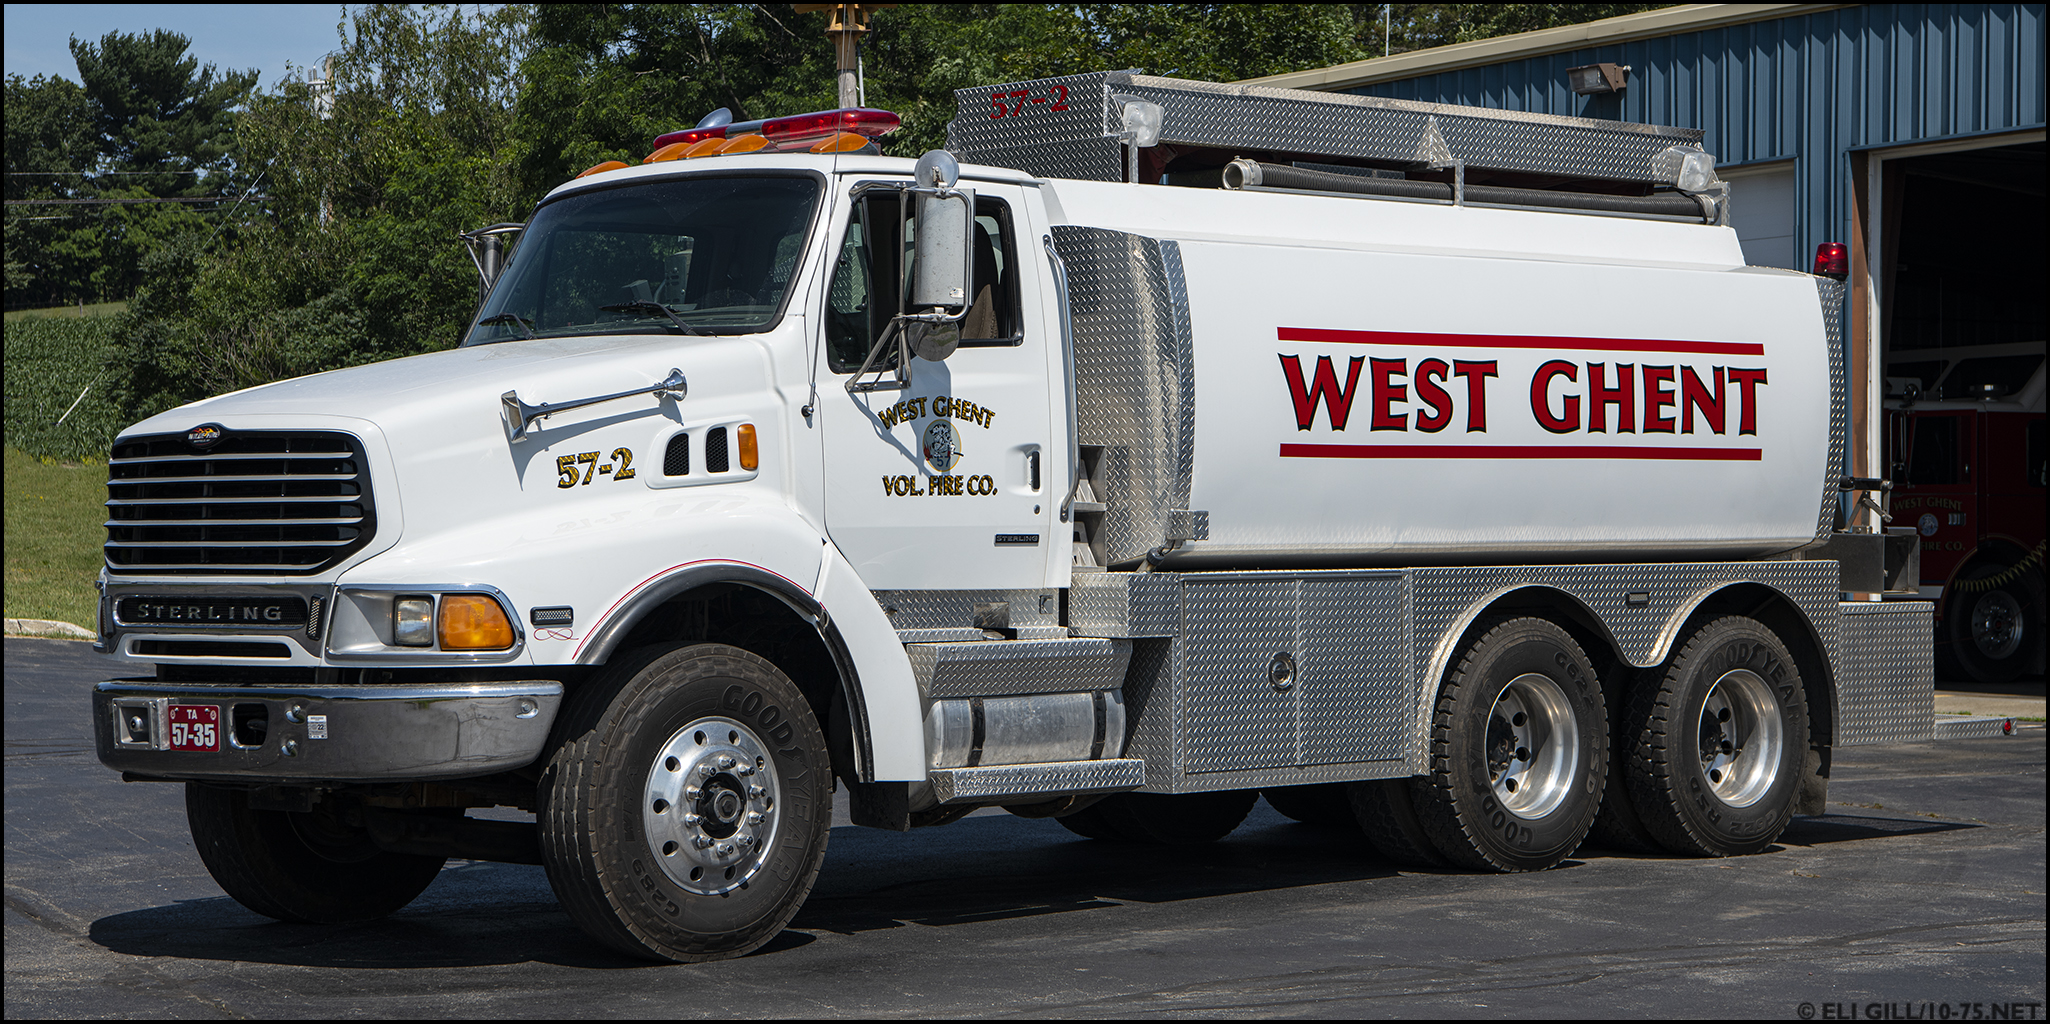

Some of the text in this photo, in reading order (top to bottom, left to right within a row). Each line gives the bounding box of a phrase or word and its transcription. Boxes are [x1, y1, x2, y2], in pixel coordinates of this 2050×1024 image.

[989, 85, 1069, 120] 57-2
[1277, 352, 1769, 437] WEST GHENT
[877, 395, 996, 430] WEST GHENT
[556, 446, 636, 489] 57-2
[936, 455, 951, 468] 57
[882, 474, 999, 497] VOL. FIRE CO.
[1893, 496, 1964, 512] WEST GHENT
[995, 534, 1039, 542] STERLING
[1920, 540, 1966, 551] FIRE CO.
[137, 602, 283, 621] STERLING
[1701, 641, 1802, 727] GOODYEAR
[186, 709, 198, 720] TA
[171, 722, 216, 747] 57-35
[1468, 678, 1535, 848] GOODYAR
[721, 683, 812, 882] GOODYEAR
[631, 858, 681, 918] G289
